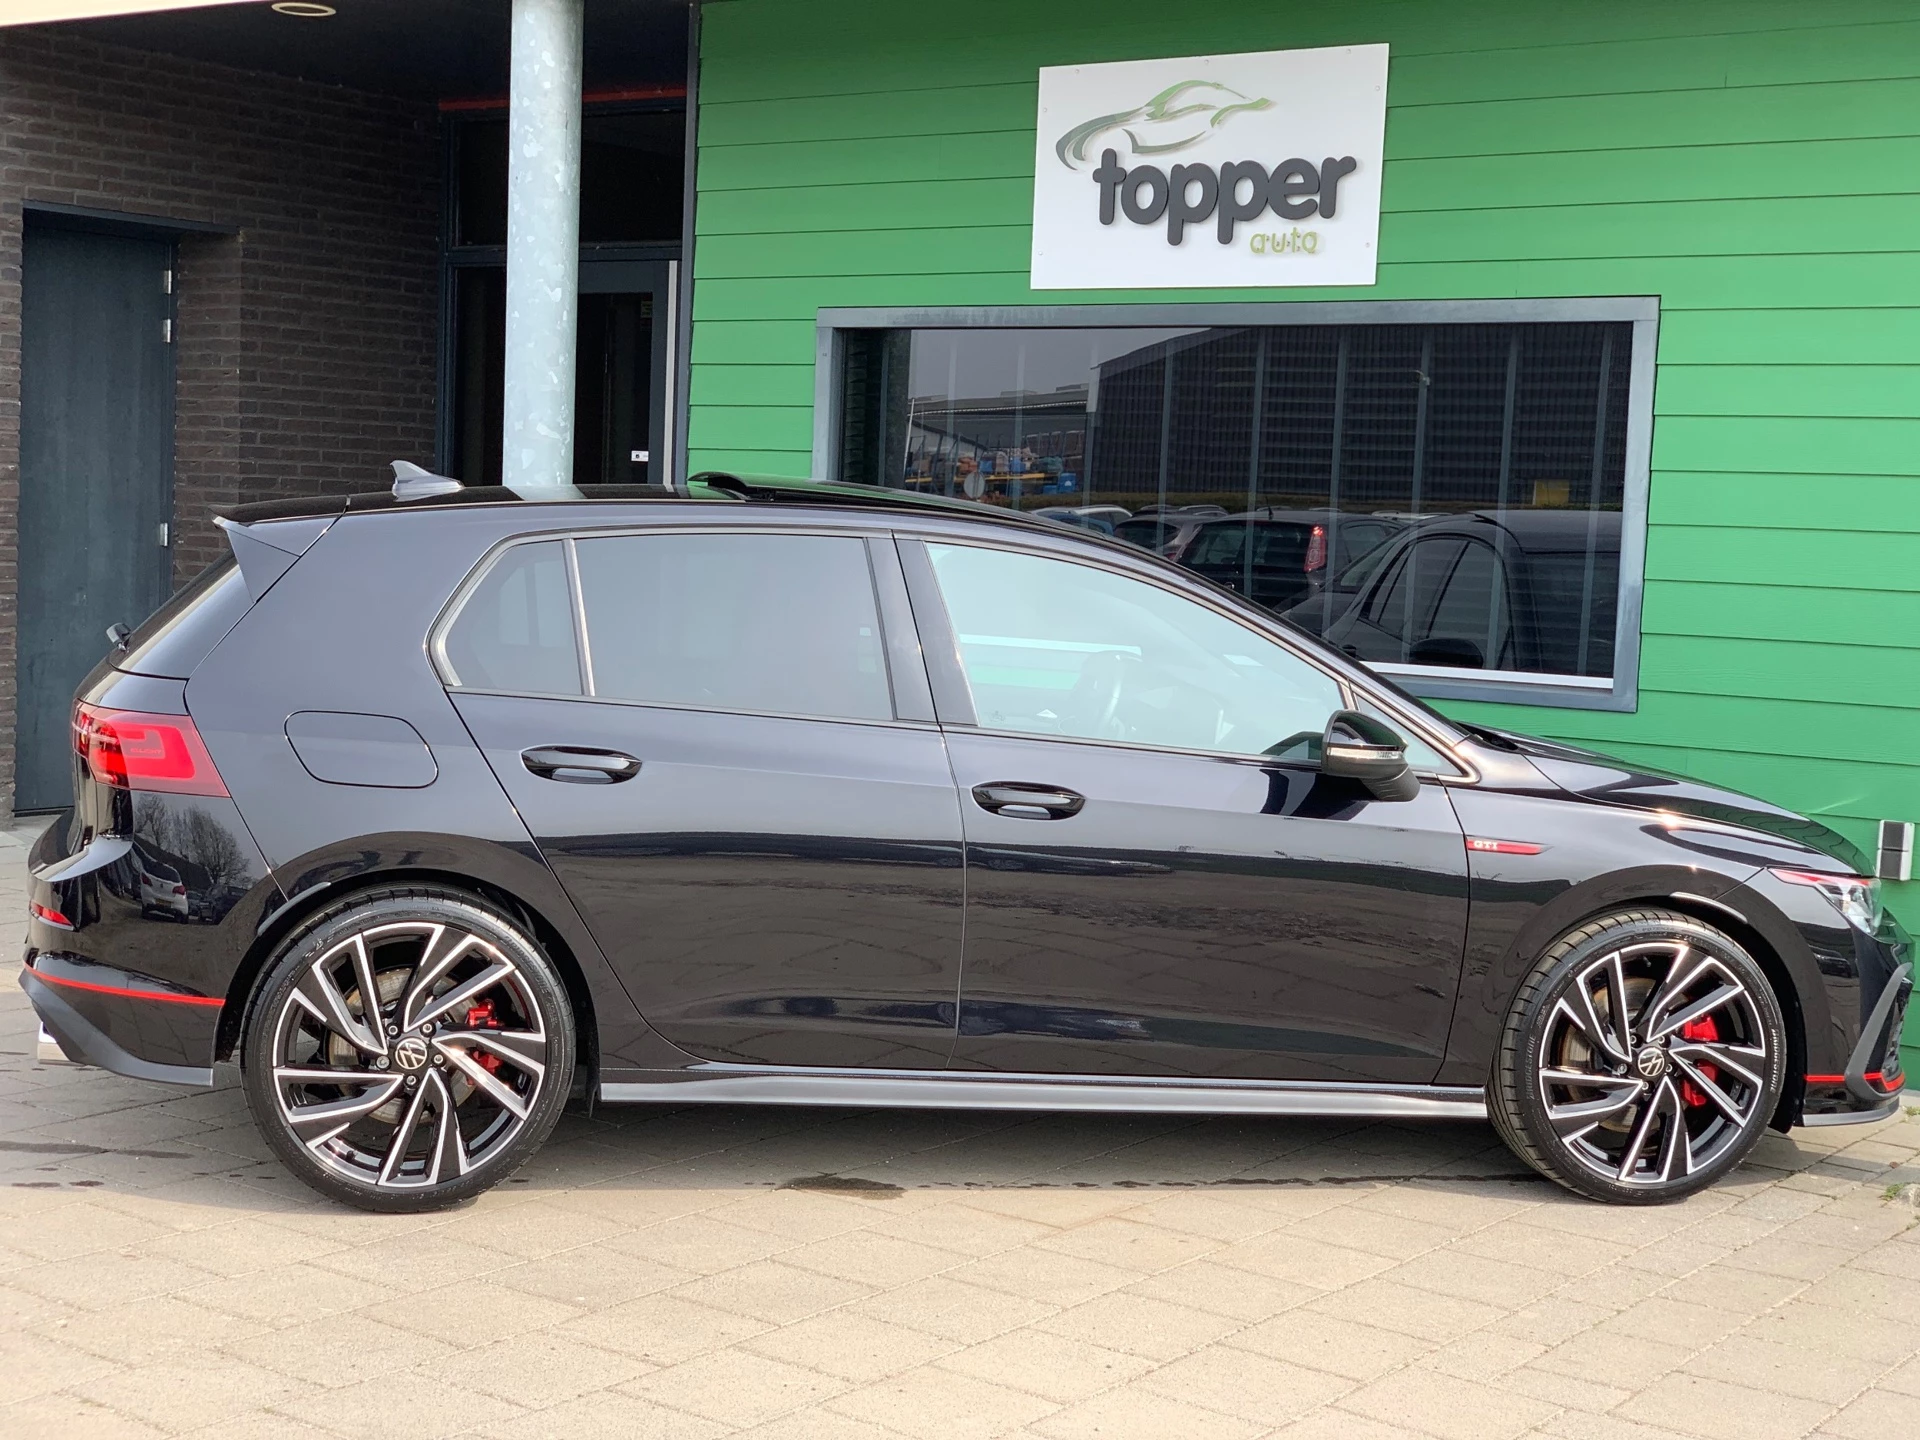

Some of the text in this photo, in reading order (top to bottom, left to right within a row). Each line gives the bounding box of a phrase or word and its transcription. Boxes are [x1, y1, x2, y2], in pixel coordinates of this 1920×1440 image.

[1092, 148, 1357, 246] topper
[1250, 227, 1318, 254] auto
[1474, 840, 1499, 850] GTI
